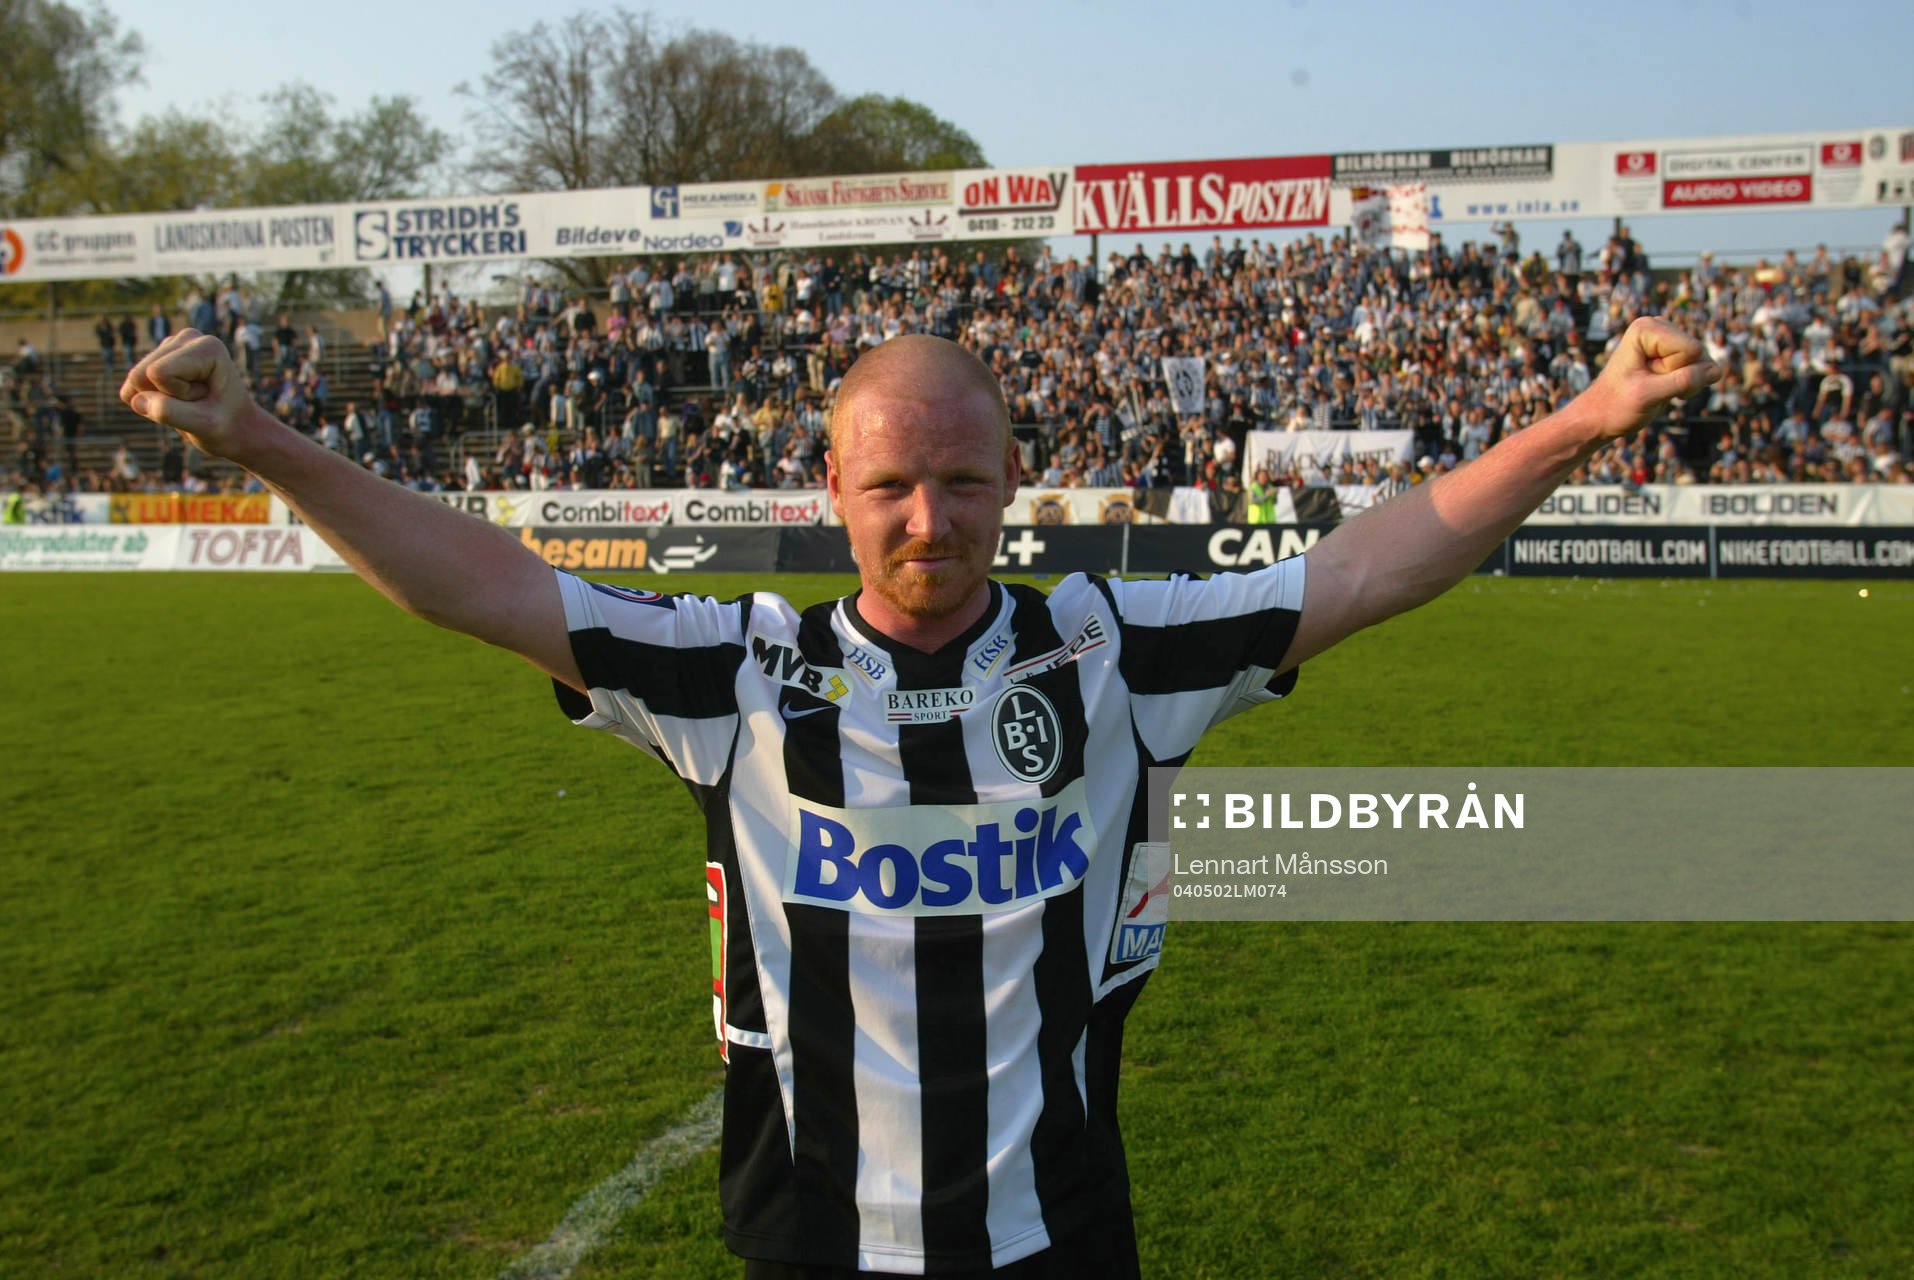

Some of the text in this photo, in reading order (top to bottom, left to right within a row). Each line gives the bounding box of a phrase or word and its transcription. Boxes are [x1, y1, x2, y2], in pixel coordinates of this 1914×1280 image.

[964, 173, 1068, 208] ON WAY
[1671, 181, 1738, 201] AUDIO
[1740, 179, 1802, 199] VIDEO
[155, 215, 335, 252] LANDSKRONA POSTEN
[394, 230, 527, 258] TRYCKERI
[556, 226, 641, 246] Bildeve
[643, 233, 724, 249] Nordea
[542, 499, 669, 522] Combitext
[686, 499, 819, 523] Combitext
[1539, 494, 1661, 514] BOLIDEN
[190, 529, 304, 566] TOFTA
[1208, 528, 1320, 566] CAN
[752, 636, 823, 693] MVB
[848, 646, 886, 680] HSB
[888, 689, 974, 709] BAREKO
[914, 711, 948, 722] SPORT
[793, 804, 1090, 910] Bostik
[1122, 926, 1163, 959] MA
